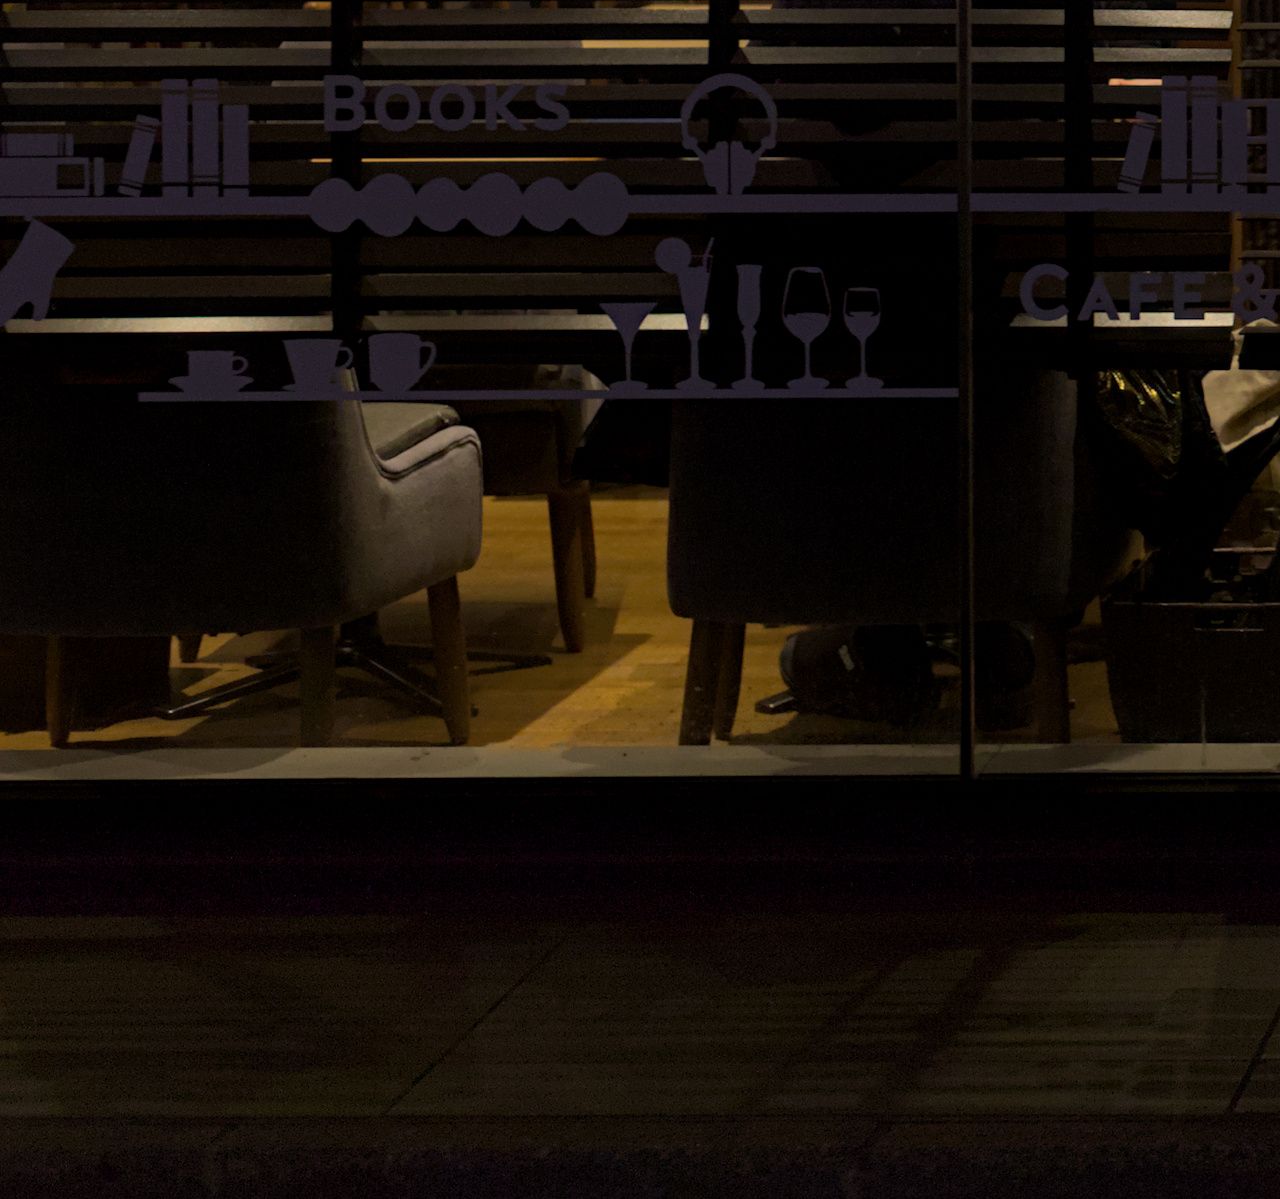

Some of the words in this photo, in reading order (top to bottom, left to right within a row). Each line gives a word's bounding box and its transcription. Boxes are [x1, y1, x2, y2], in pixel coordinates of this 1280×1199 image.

[322, 73, 571, 132] BOOKS
[1018, 263, 1207, 321] CAFE
[1232, 263, 1280, 321] &
